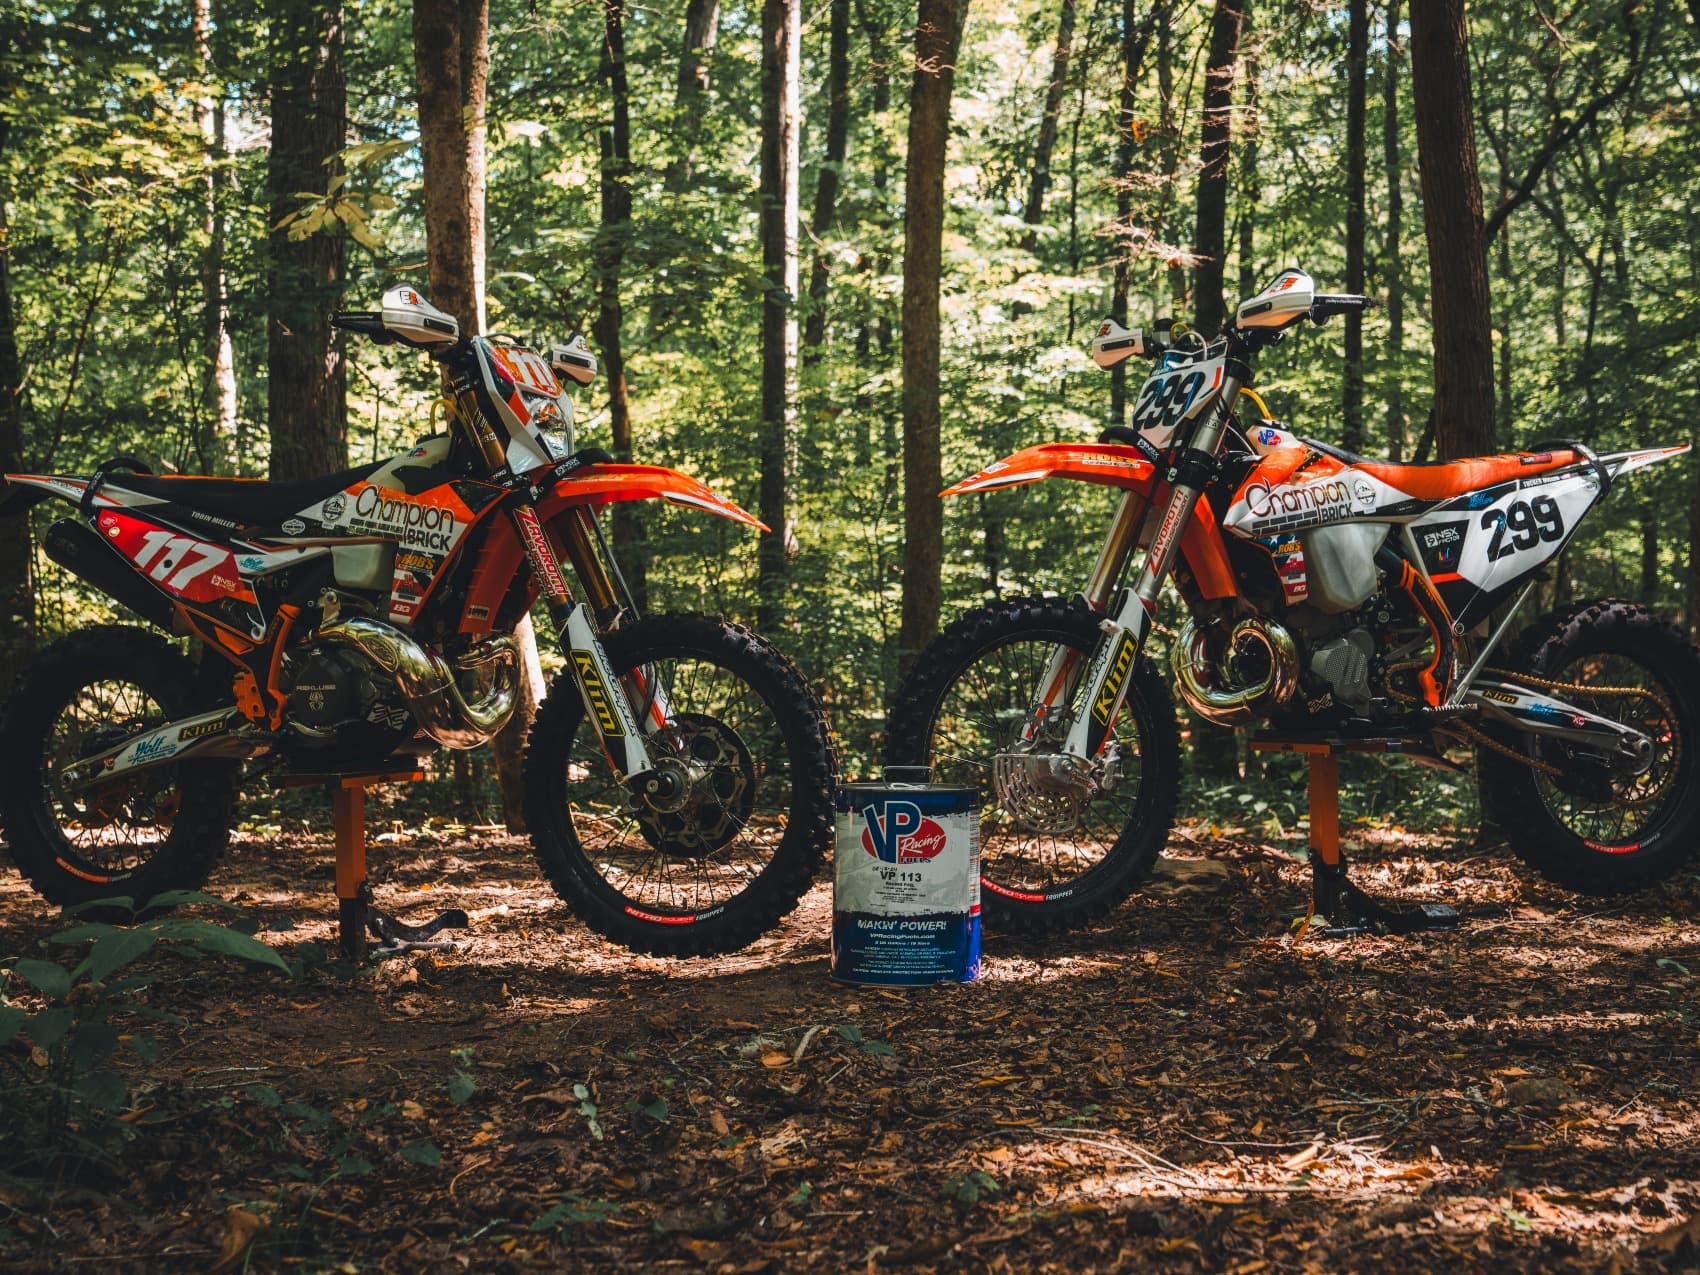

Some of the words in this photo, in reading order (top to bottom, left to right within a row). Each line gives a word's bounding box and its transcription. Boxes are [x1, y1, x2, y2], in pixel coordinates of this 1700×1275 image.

[1133, 371, 1206, 430] 299
[1246, 478, 1351, 525] Champion
[1321, 503, 1354, 522] BRICK
[191, 511, 212, 522] TOBIN
[212, 517, 236, 529] MILLER
[356, 485, 454, 545] Champion
[407, 529, 452, 551] BRICK
[1435, 527, 1459, 540] NSX
[1481, 495, 1565, 563] 299
[134, 531, 230, 590] 117
[862, 801, 922, 864] VP
[901, 833, 945, 857] Racing
[880, 871, 896, 880] VP
[900, 872, 922, 882] 113
[857, 919, 898, 930] MAKIN'
[900, 920, 947, 931] POWER!
